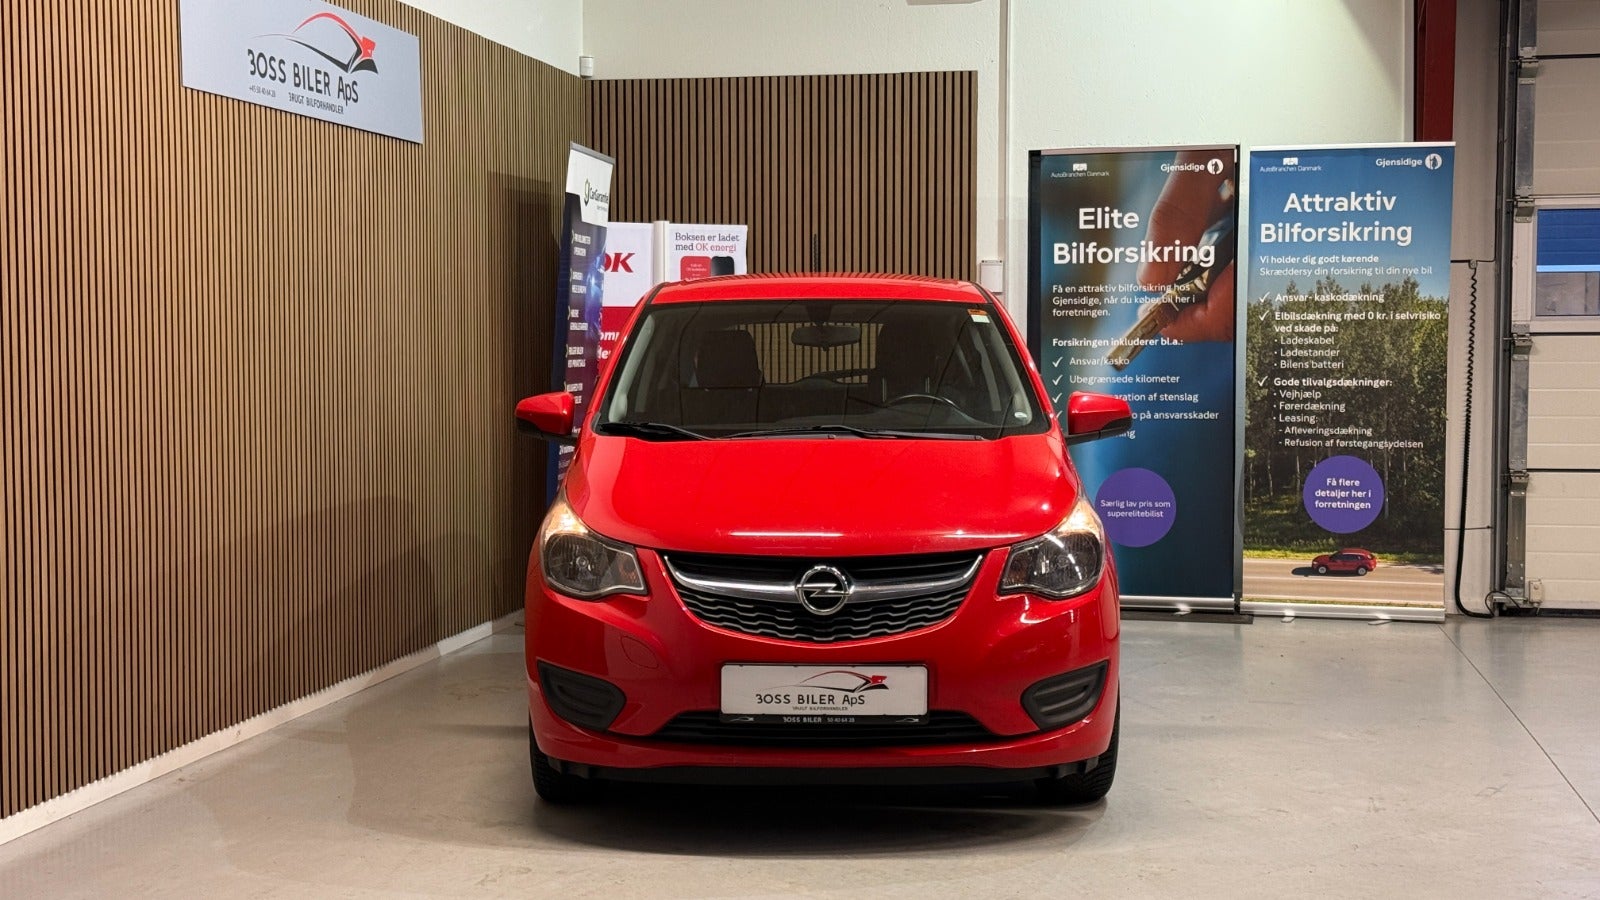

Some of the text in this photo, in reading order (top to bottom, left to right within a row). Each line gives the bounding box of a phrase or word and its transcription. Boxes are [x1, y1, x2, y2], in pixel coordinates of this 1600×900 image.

[293, 63, 331, 96] BILER
[338, 76, 359, 106] ApS
[1376, 158, 1422, 168] Gjensidige
[1160, 163, 1205, 174] Gjensidige
[1284, 190, 1396, 212] Attraktiv
[1079, 206, 1140, 229] Elite
[675, 233, 705, 241] Boksen
[1260, 221, 1412, 247] Bilforsikring
[710, 244, 736, 253] energi
[1054, 240, 1216, 267] Bilforsikring
[1271, 255, 1300, 263] holder
[1302, 255, 1316, 265] dig
[1318, 255, 1340, 264] godt
[1342, 254, 1379, 263] kørende
[1260, 267, 1312, 277] Skræddersy
[1314, 267, 1328, 275] din
[1330, 266, 1372, 276] forsikring
[1374, 266, 1384, 274] til
[1386, 266, 1400, 274] din
[1421, 266, 1432, 274] bil
[1053, 284, 1063, 293] Få
[1078, 284, 1116, 293] attraktiv
[1118, 283, 1171, 295] bilforsikring
[1174, 284, 1190, 292] hos
[1053, 296, 1102, 306] Gjensidige,
[1104, 296, 1118, 304] når
[1121, 296, 1132, 304] du
[1176, 295, 1190, 303] her
[1275, 293, 1384, 303] Ansvar- kaskodækning
[1052, 308, 1111, 318] forretningen.
[1275, 312, 1342, 322] Elbilsdækning
[1395, 312, 1441, 320] selvrisiko
[1275, 324, 1339, 335] ved skade på:
[1053, 338, 1109, 348] Forsikringen
[1111, 338, 1159, 346] inkluderer
[1280, 336, 1334, 345] Ladeskabel
[1069, 357, 1130, 365] Ansvar/kasko
[1311, 360, 1344, 369] batteri
[1070, 375, 1180, 385] Ubegrænsede kilometer
[1274, 378, 1393, 388] Gode tilvalgsdækninger:
[1148, 392, 1157, 401] af
[1159, 392, 1199, 403] stenslag
[1280, 390, 1322, 399] Vejhjælp
[1280, 402, 1346, 412] Førerdækning
[1140, 410, 1152, 421] på
[1154, 411, 1219, 420] ansvarsskader
[1279, 414, 1318, 424] Leasing:
[1285, 426, 1372, 436] Afleveringsdækning
[1336, 439, 1424, 449] førstegangsydelsen
[1315, 489, 1349, 499] detaljer
[1100, 500, 1125, 509] Særlig
[1139, 500, 1153, 509] pris
[1315, 500, 1371, 510] forretningen
[1107, 510, 1164, 519] superelitebilist
[798, 694, 835, 704] BILER
[842, 694, 865, 707] ApS
